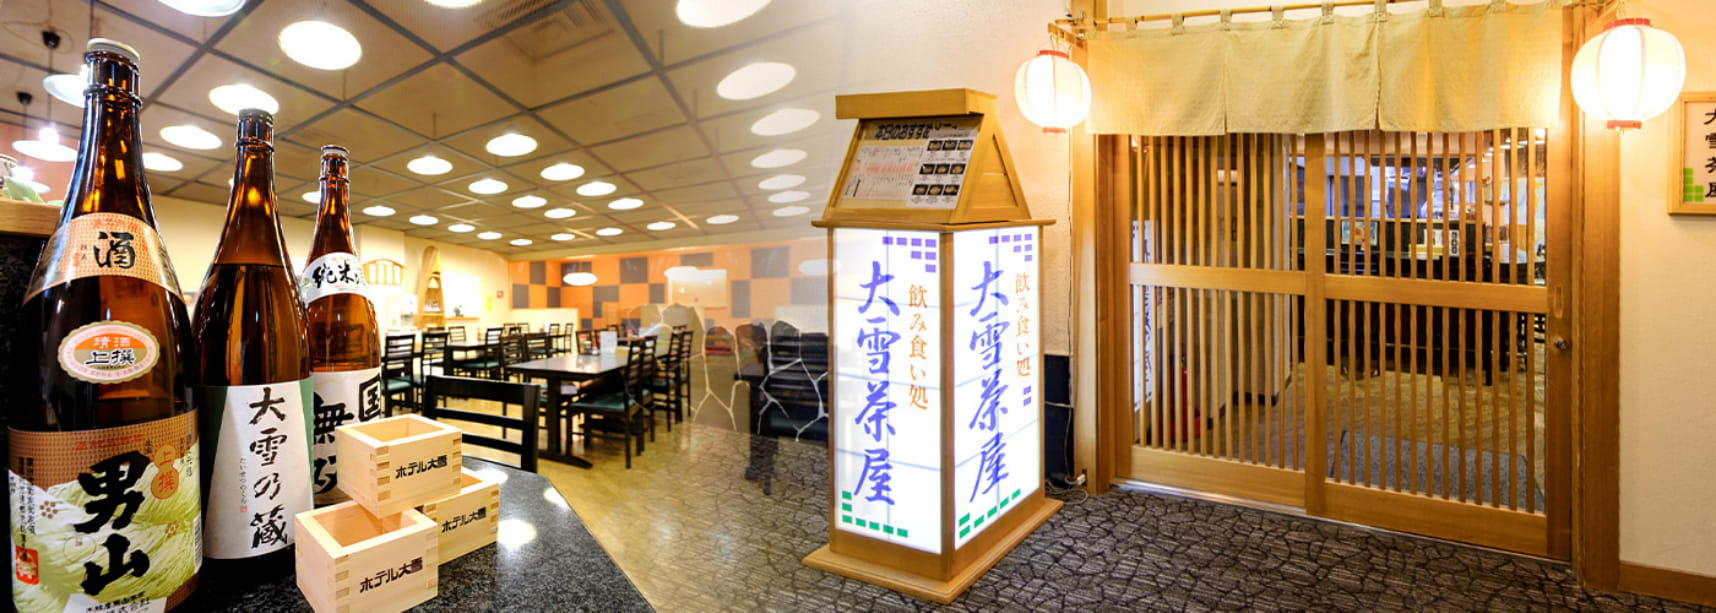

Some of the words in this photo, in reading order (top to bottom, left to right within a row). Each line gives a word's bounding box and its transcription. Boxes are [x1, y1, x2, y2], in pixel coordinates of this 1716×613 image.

[93, 231, 137, 269] 酒
[312, 259, 360, 289] 純米
[93, 336, 131, 349] 清酒
[1015, 272, 1031, 377] 飲み食い処
[85, 348, 136, 366] 上撰
[908, 283, 928, 410] 飲み食い処
[853, 260, 901, 505] 大雪茶屋
[969, 260, 1010, 503] 大雪茶屋
[395, 454, 448, 479] ホテル大雪
[73, 450, 151, 596] 男山
[441, 507, 487, 533] ホテル大雪
[359, 556, 423, 593] ホテル大雪
